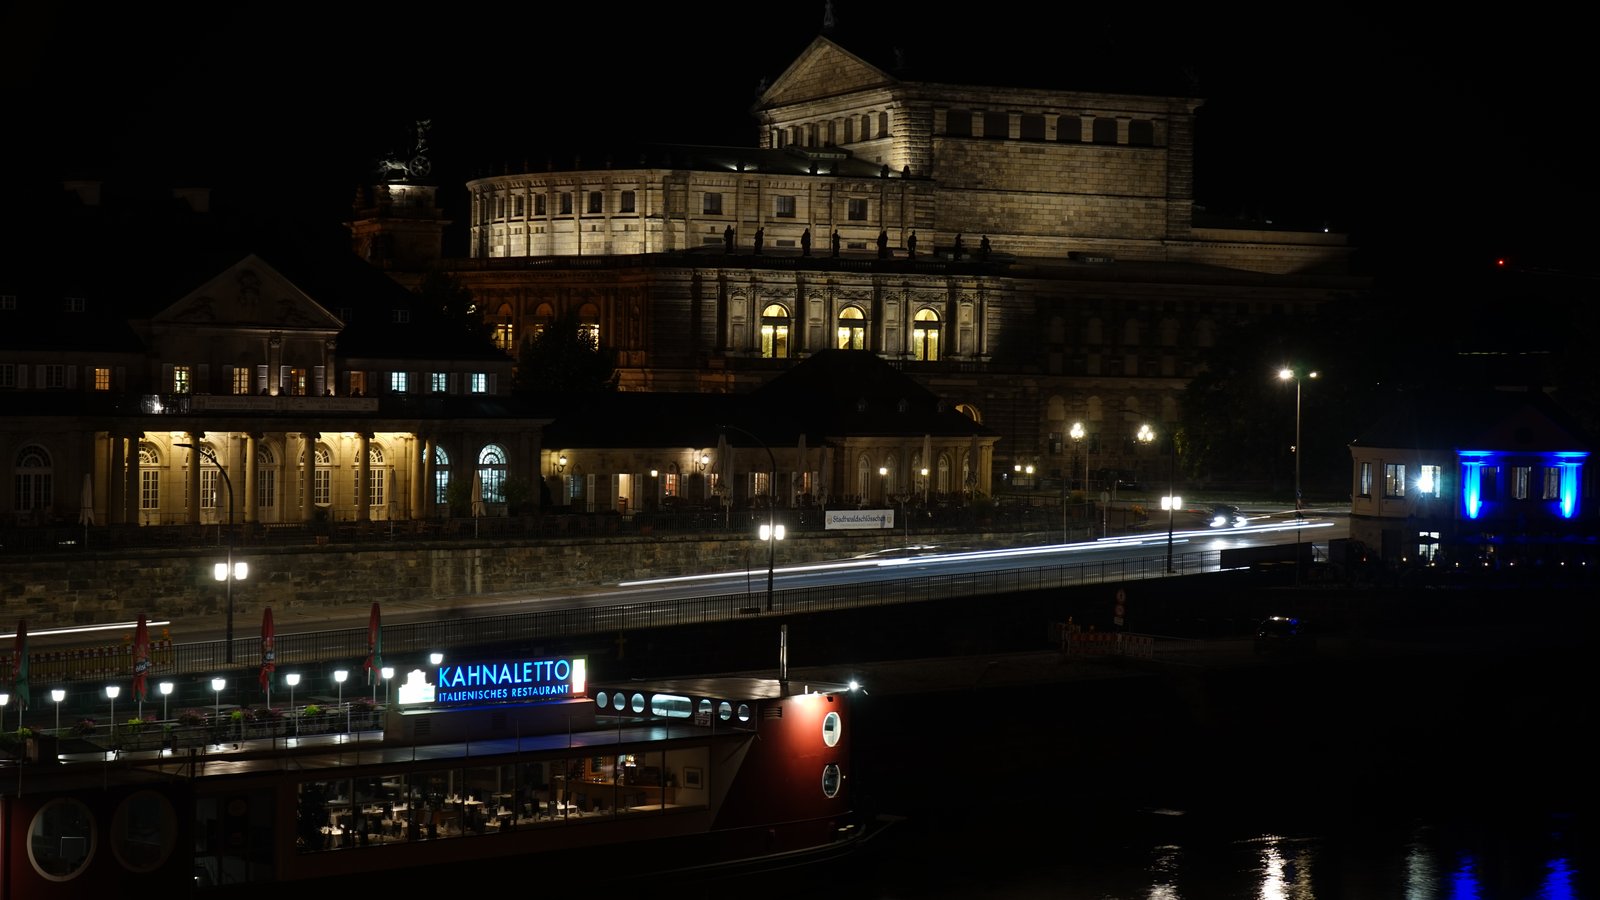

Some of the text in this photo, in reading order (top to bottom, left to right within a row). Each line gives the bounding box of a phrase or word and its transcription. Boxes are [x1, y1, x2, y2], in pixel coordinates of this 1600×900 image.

[438, 659, 570, 688] KAHNALETTO
[439, 684, 570, 702] ITALIENISCHES RESTAURANT
